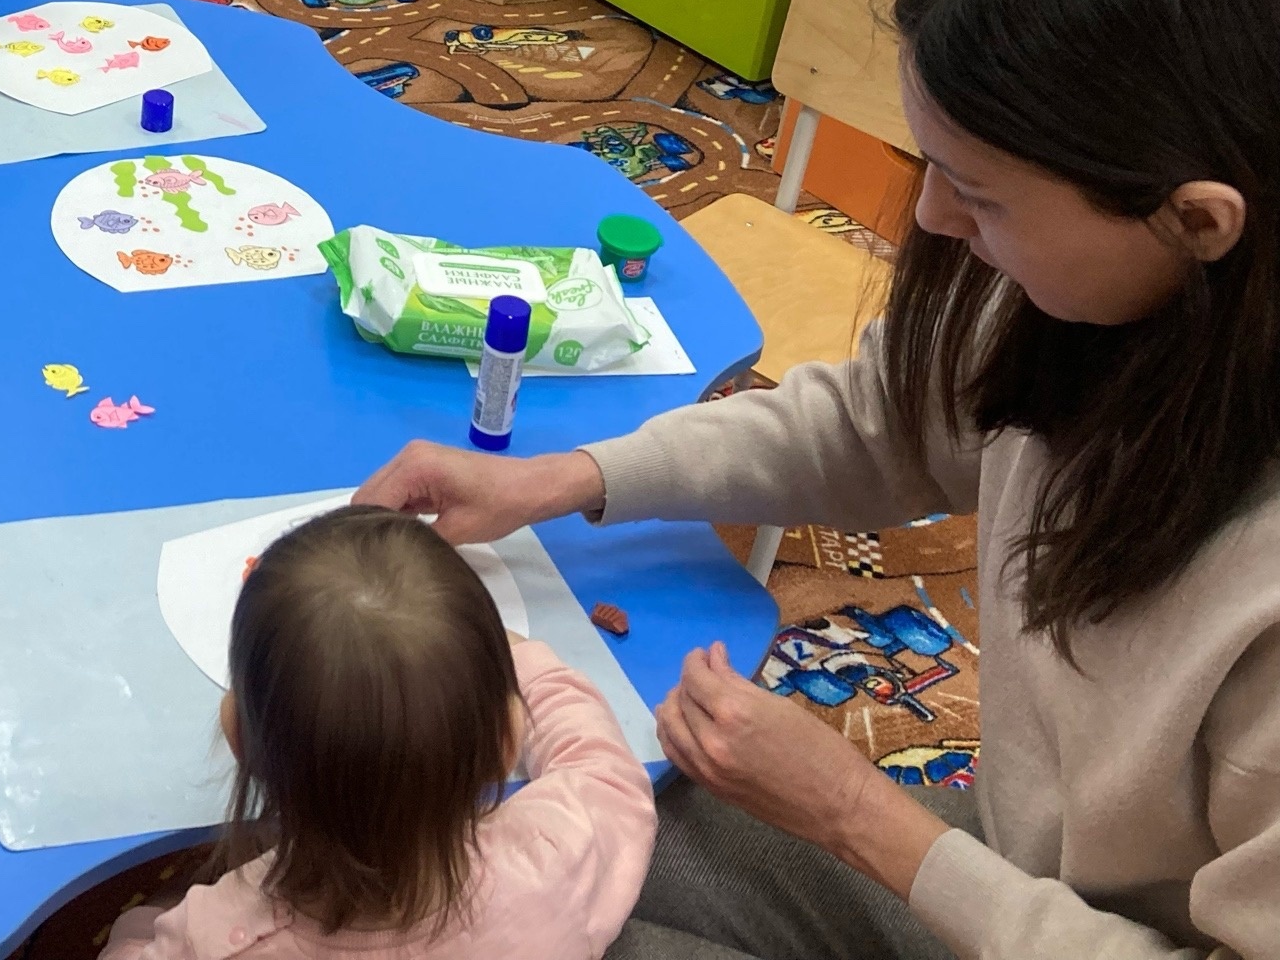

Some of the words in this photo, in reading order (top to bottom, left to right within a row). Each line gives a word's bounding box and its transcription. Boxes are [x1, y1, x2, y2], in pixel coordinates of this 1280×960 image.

[447, 277, 523, 290] ВЛАЖНЫЕ
[421, 319, 483, 338] ВЛАЖН
[418, 332, 484, 348] САЛФЕТК
[818, 525, 847, 571] ТАРТ
